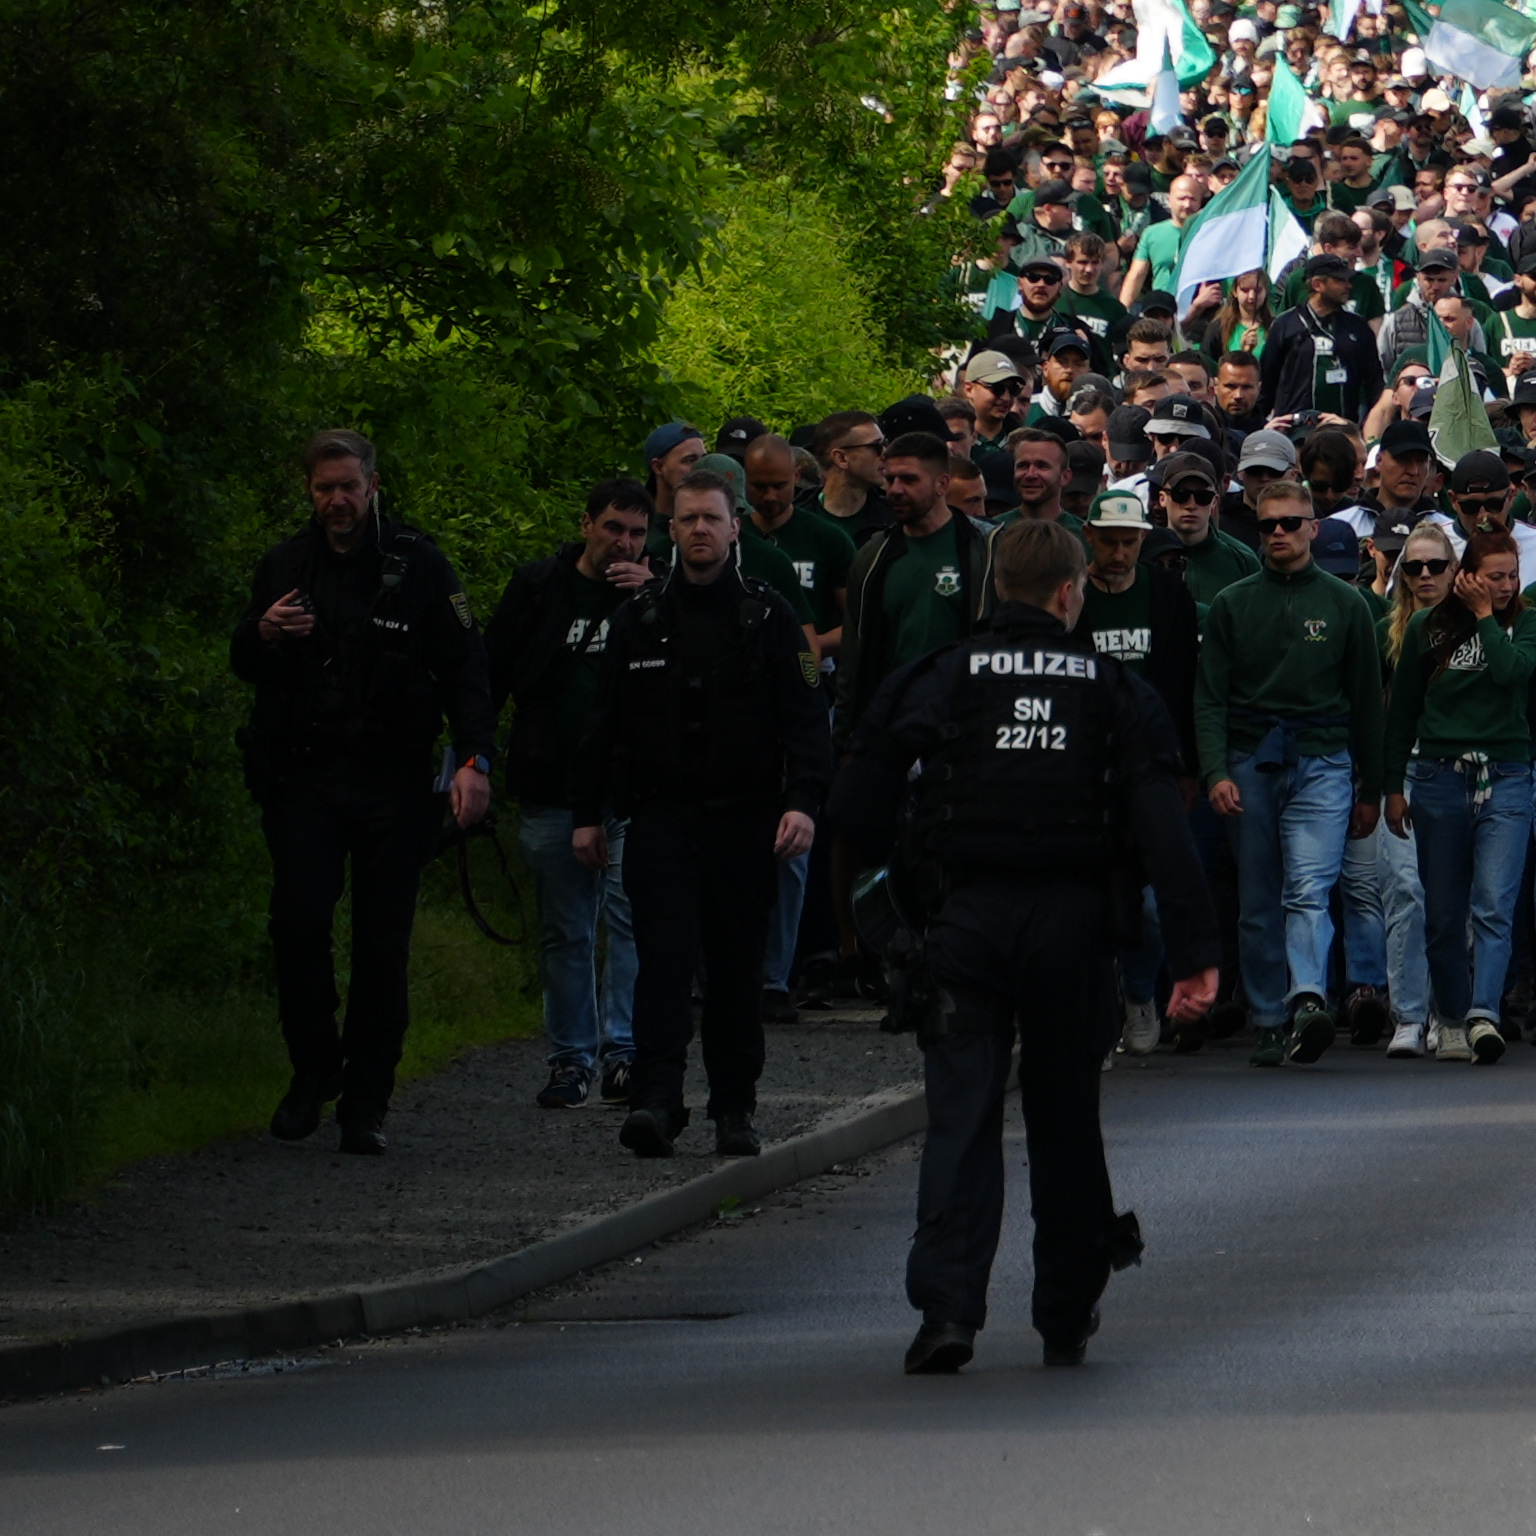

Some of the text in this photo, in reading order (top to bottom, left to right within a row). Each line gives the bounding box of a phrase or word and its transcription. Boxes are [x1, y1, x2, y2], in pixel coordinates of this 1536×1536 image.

[1092, 628, 1152, 653] HEMI
[970, 651, 1096, 680] POLIZEI
[1014, 697, 1051, 721] SN
[995, 725, 1066, 750] 22/12
